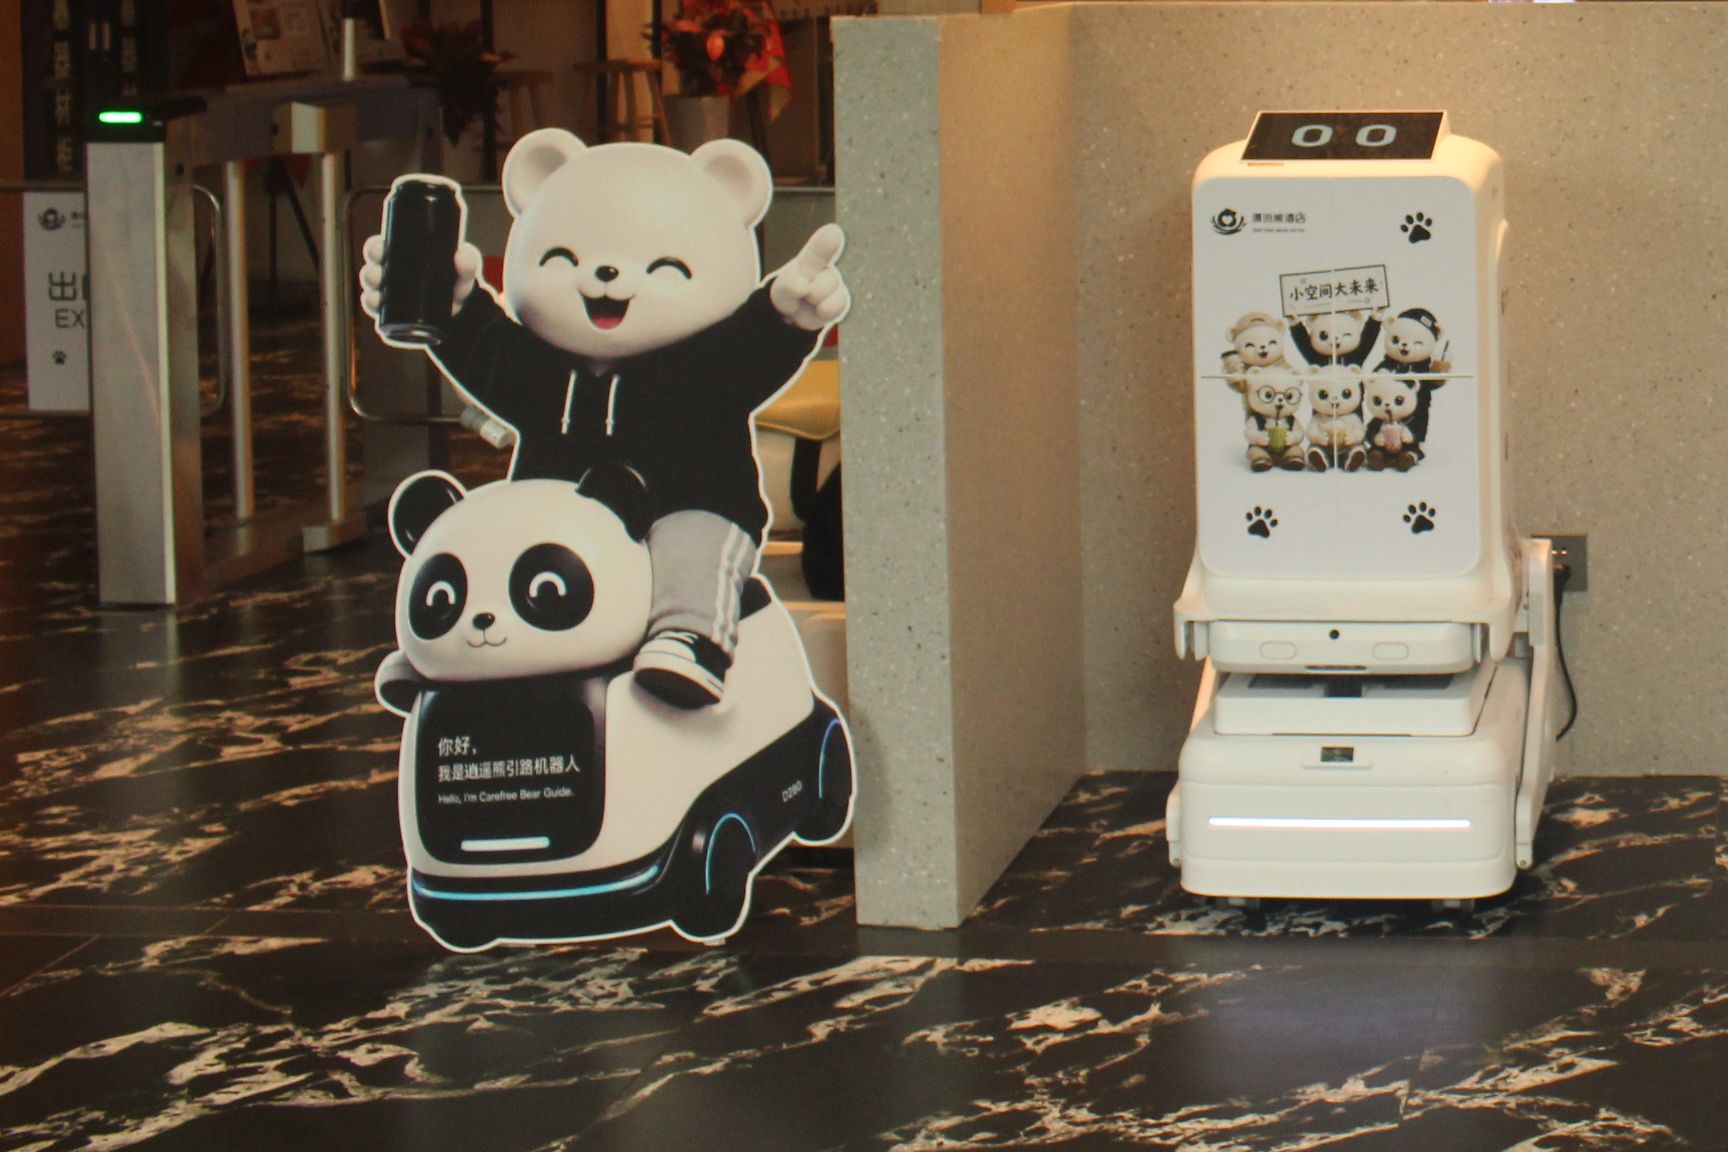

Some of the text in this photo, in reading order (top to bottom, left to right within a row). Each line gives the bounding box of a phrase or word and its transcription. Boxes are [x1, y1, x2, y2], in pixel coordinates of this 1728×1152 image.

[1290, 277, 1379, 301] 小空间大未来
[438, 754, 581, 783] 我是逍遥熊引路机器人
[438, 794, 461, 804] Hello,
[479, 790, 518, 802] Carefree
[519, 789, 541, 800] Bear
